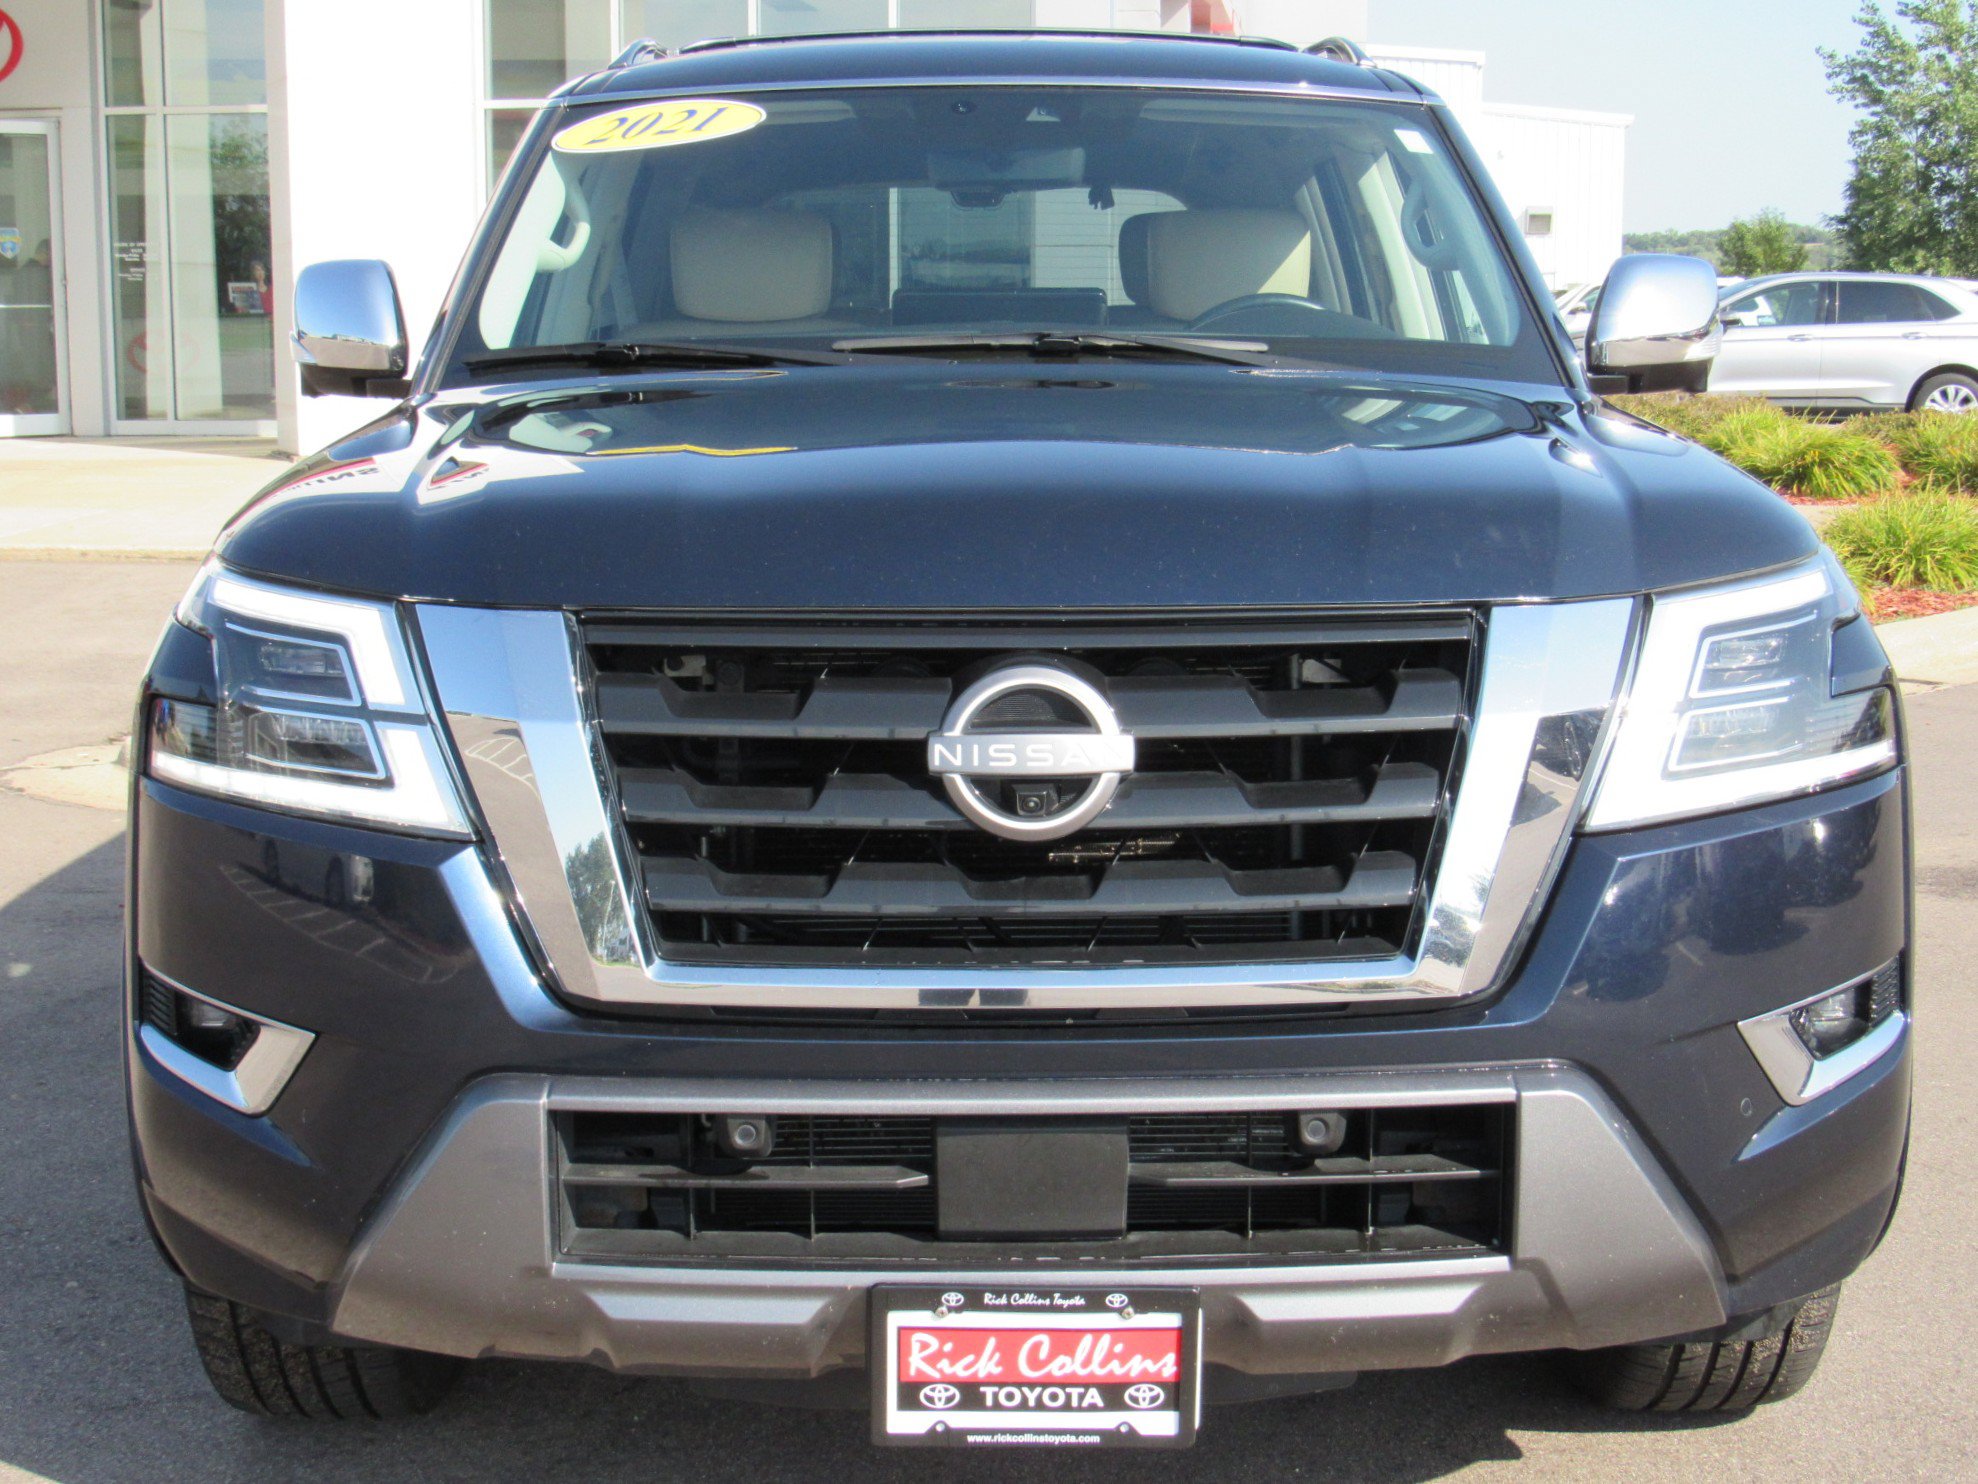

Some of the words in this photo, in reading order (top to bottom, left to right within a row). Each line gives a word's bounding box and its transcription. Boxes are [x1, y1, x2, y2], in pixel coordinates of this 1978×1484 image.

[582, 107, 729, 146] 2021
[934, 743, 1126, 767] NISSA
[983, 1292, 1008, 1306] Rick
[1010, 1292, 1051, 1306] Collins
[1053, 1292, 1086, 1309] Toyota
[909, 1332, 1003, 1379] Rick
[1017, 1333, 1178, 1379] Collins
[979, 1386, 1105, 1408] TOYOTA
[966, 1433, 1101, 1445] www.rickcollinstoyota.com
